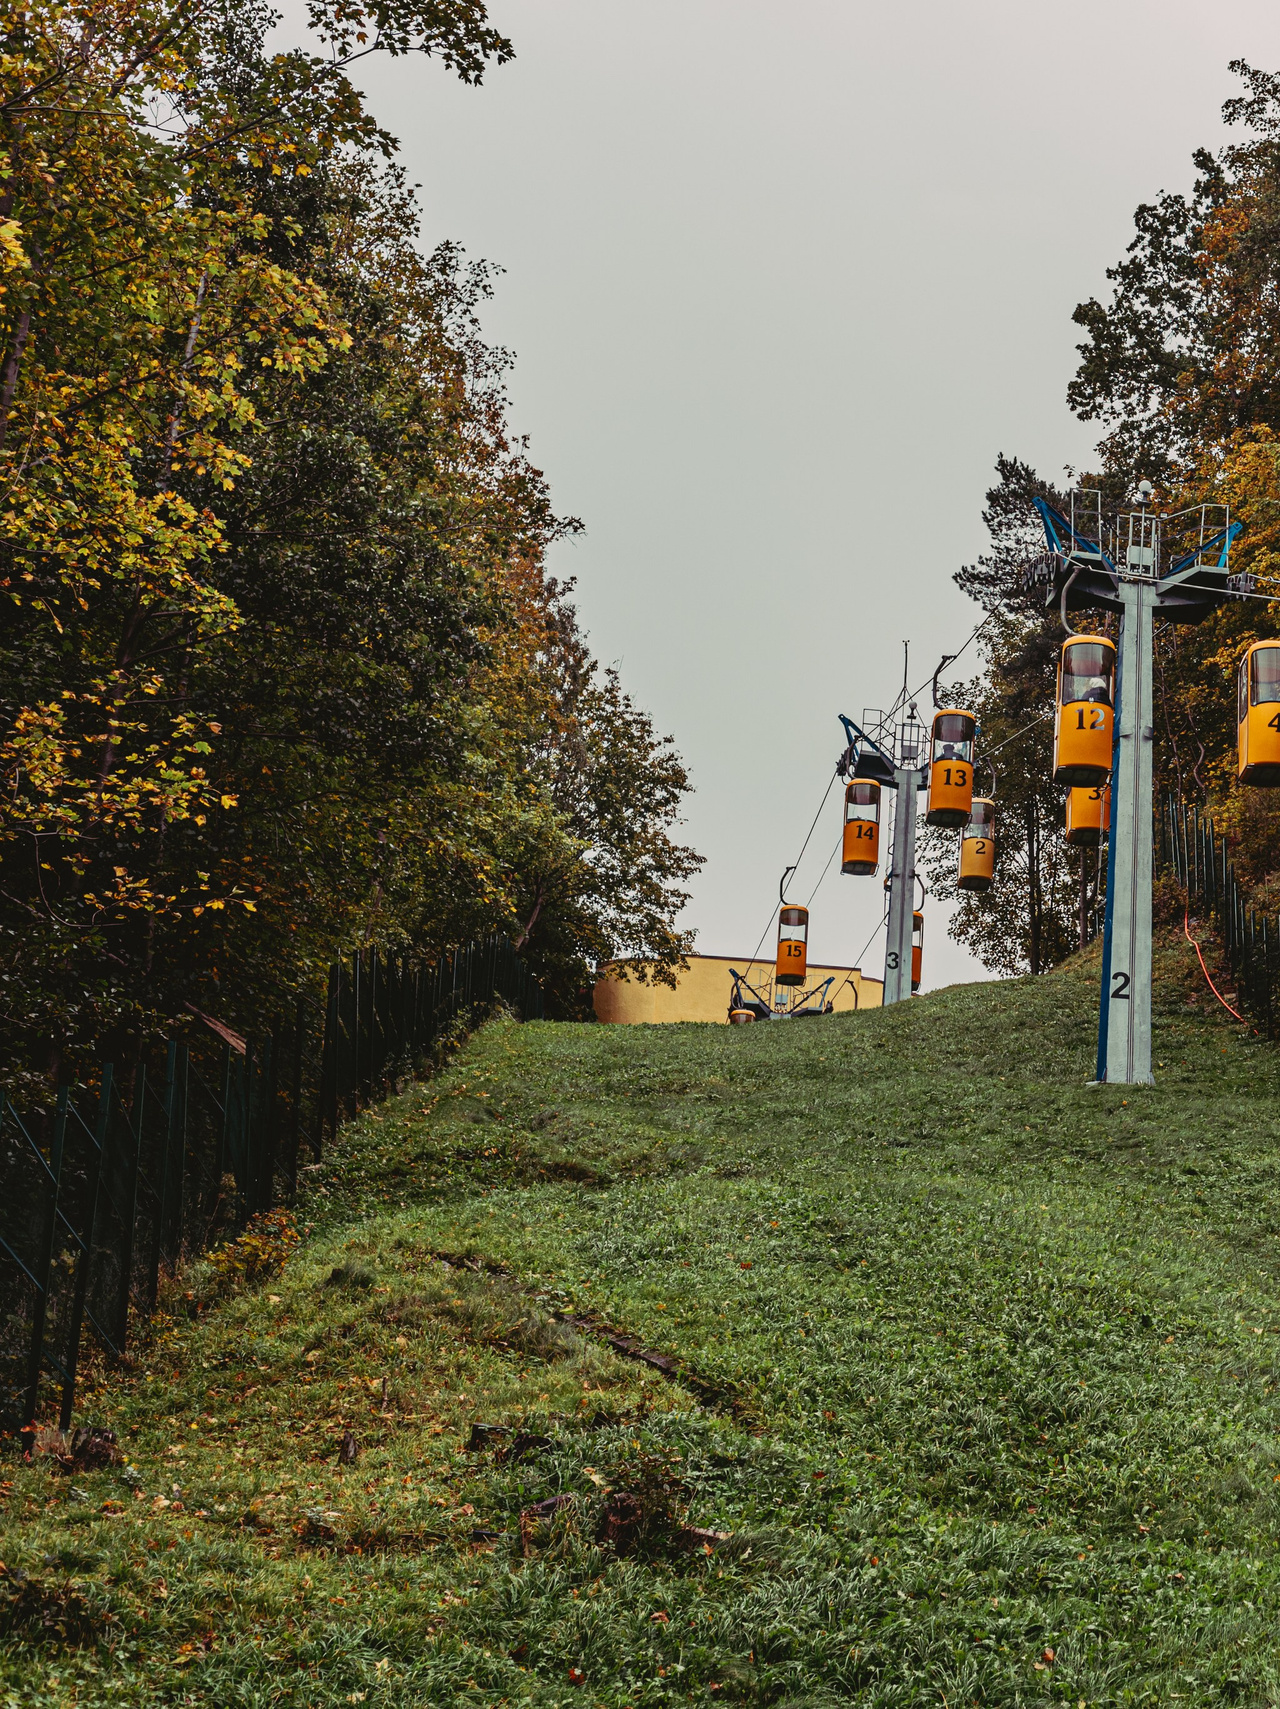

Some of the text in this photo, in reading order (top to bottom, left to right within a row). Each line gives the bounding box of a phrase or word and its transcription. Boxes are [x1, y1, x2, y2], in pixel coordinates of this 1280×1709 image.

[1075, 708, 1105, 731] 12
[943, 768, 967, 787] 13
[1088, 787, 1101, 800] 3
[856, 825, 874, 840] 14
[975, 840, 986, 855] 2
[786, 945, 802, 957] 15
[887, 952, 898, 969] 3
[1111, 972, 1130, 999] 2
